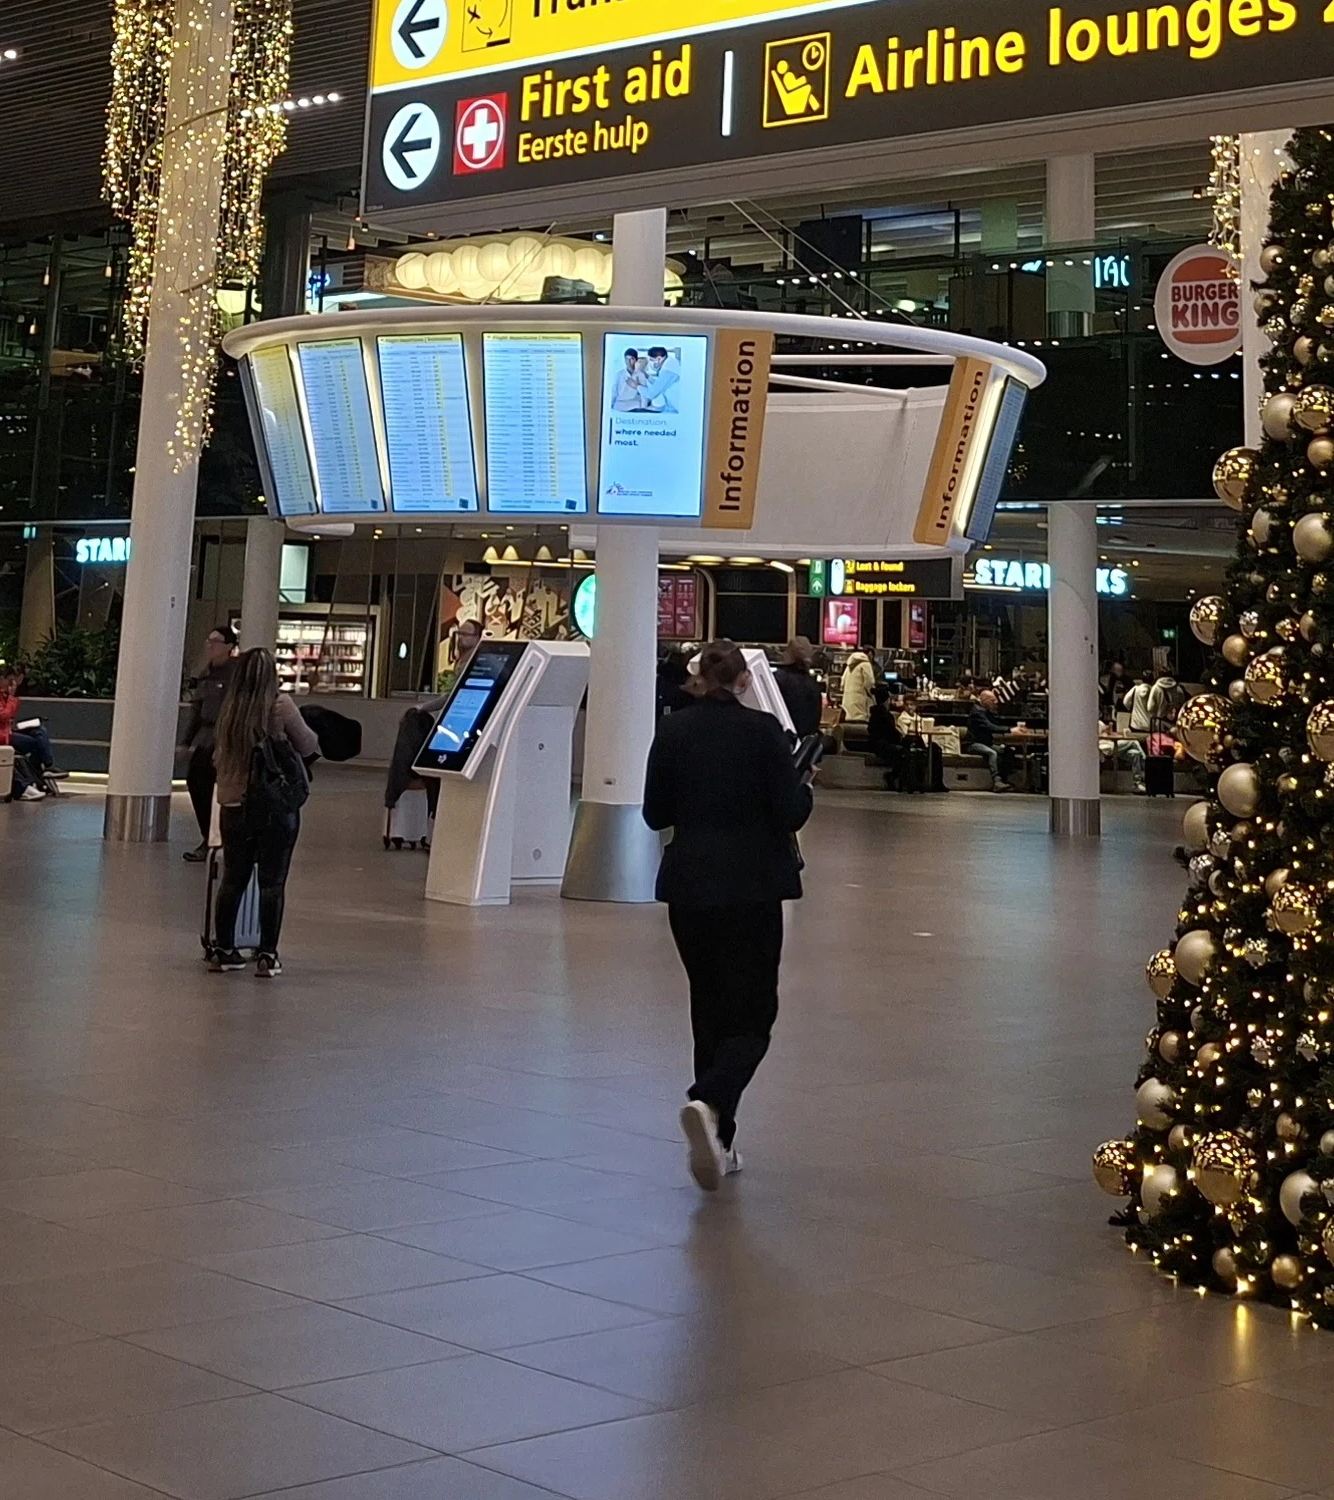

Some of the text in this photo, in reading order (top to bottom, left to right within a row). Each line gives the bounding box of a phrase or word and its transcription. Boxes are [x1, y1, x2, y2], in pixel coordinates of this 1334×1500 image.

[519, 43, 691, 121] First aid
[845, 26, 1024, 97] Airline
[517, 114, 649, 163] Eerste hulp
[1171, 282, 1239, 302] BURGER
[1171, 301, 1239, 328] KING
[719, 341, 755, 511] Information
[935, 370, 984, 529] Information
[855, 581, 887, 593] Baggage
